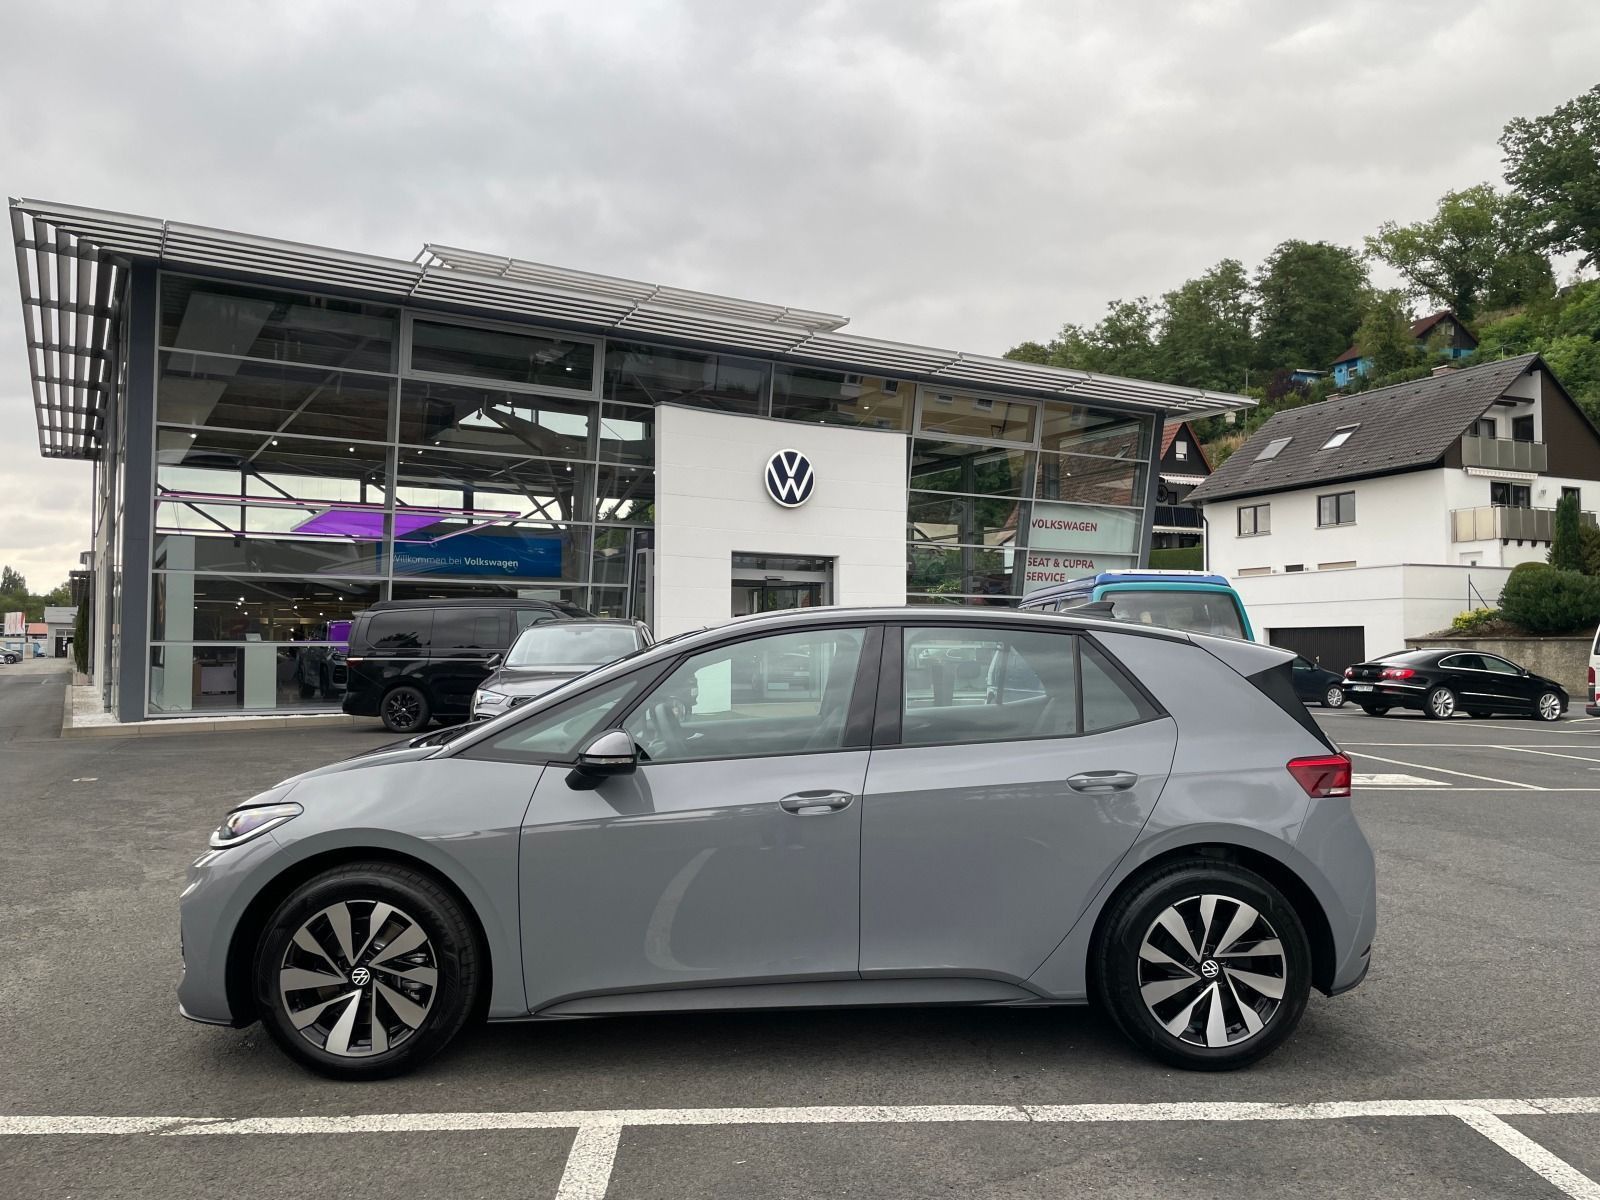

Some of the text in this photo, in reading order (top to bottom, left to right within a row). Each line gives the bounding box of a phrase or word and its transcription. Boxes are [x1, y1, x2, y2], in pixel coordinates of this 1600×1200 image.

[765, 449, 815, 507] VW
[1032, 518, 1098, 532] VOLKSWAGEN
[393, 554, 518, 568] Willkommen bei Volkswagen
[1027, 557, 1095, 569] SEAT & CUPRA
[1026, 572, 1065, 582] SERVICE
